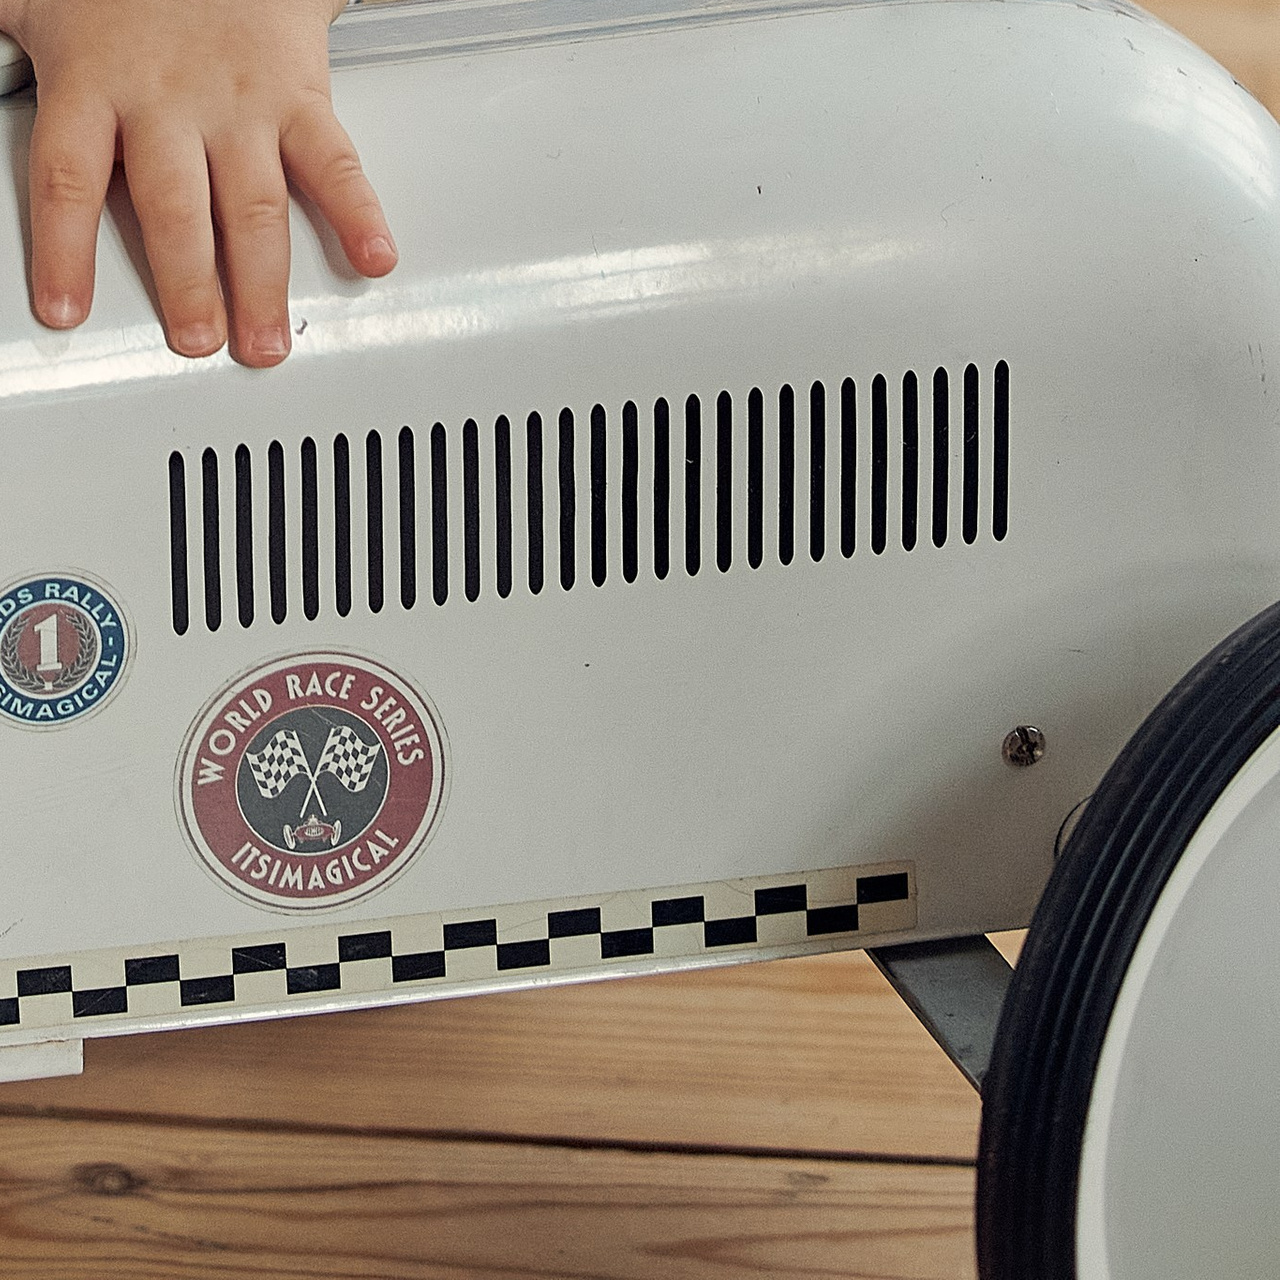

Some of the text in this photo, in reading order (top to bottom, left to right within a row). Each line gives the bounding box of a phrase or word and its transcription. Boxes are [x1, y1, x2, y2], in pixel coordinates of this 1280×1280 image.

[44, 582, 118, 629] RALLY
[33, 613, 63, 672] 1
[197, 670, 425, 786] WORLD RACE SERIES
[230, 828, 400, 892] ITSIMAGICAL
